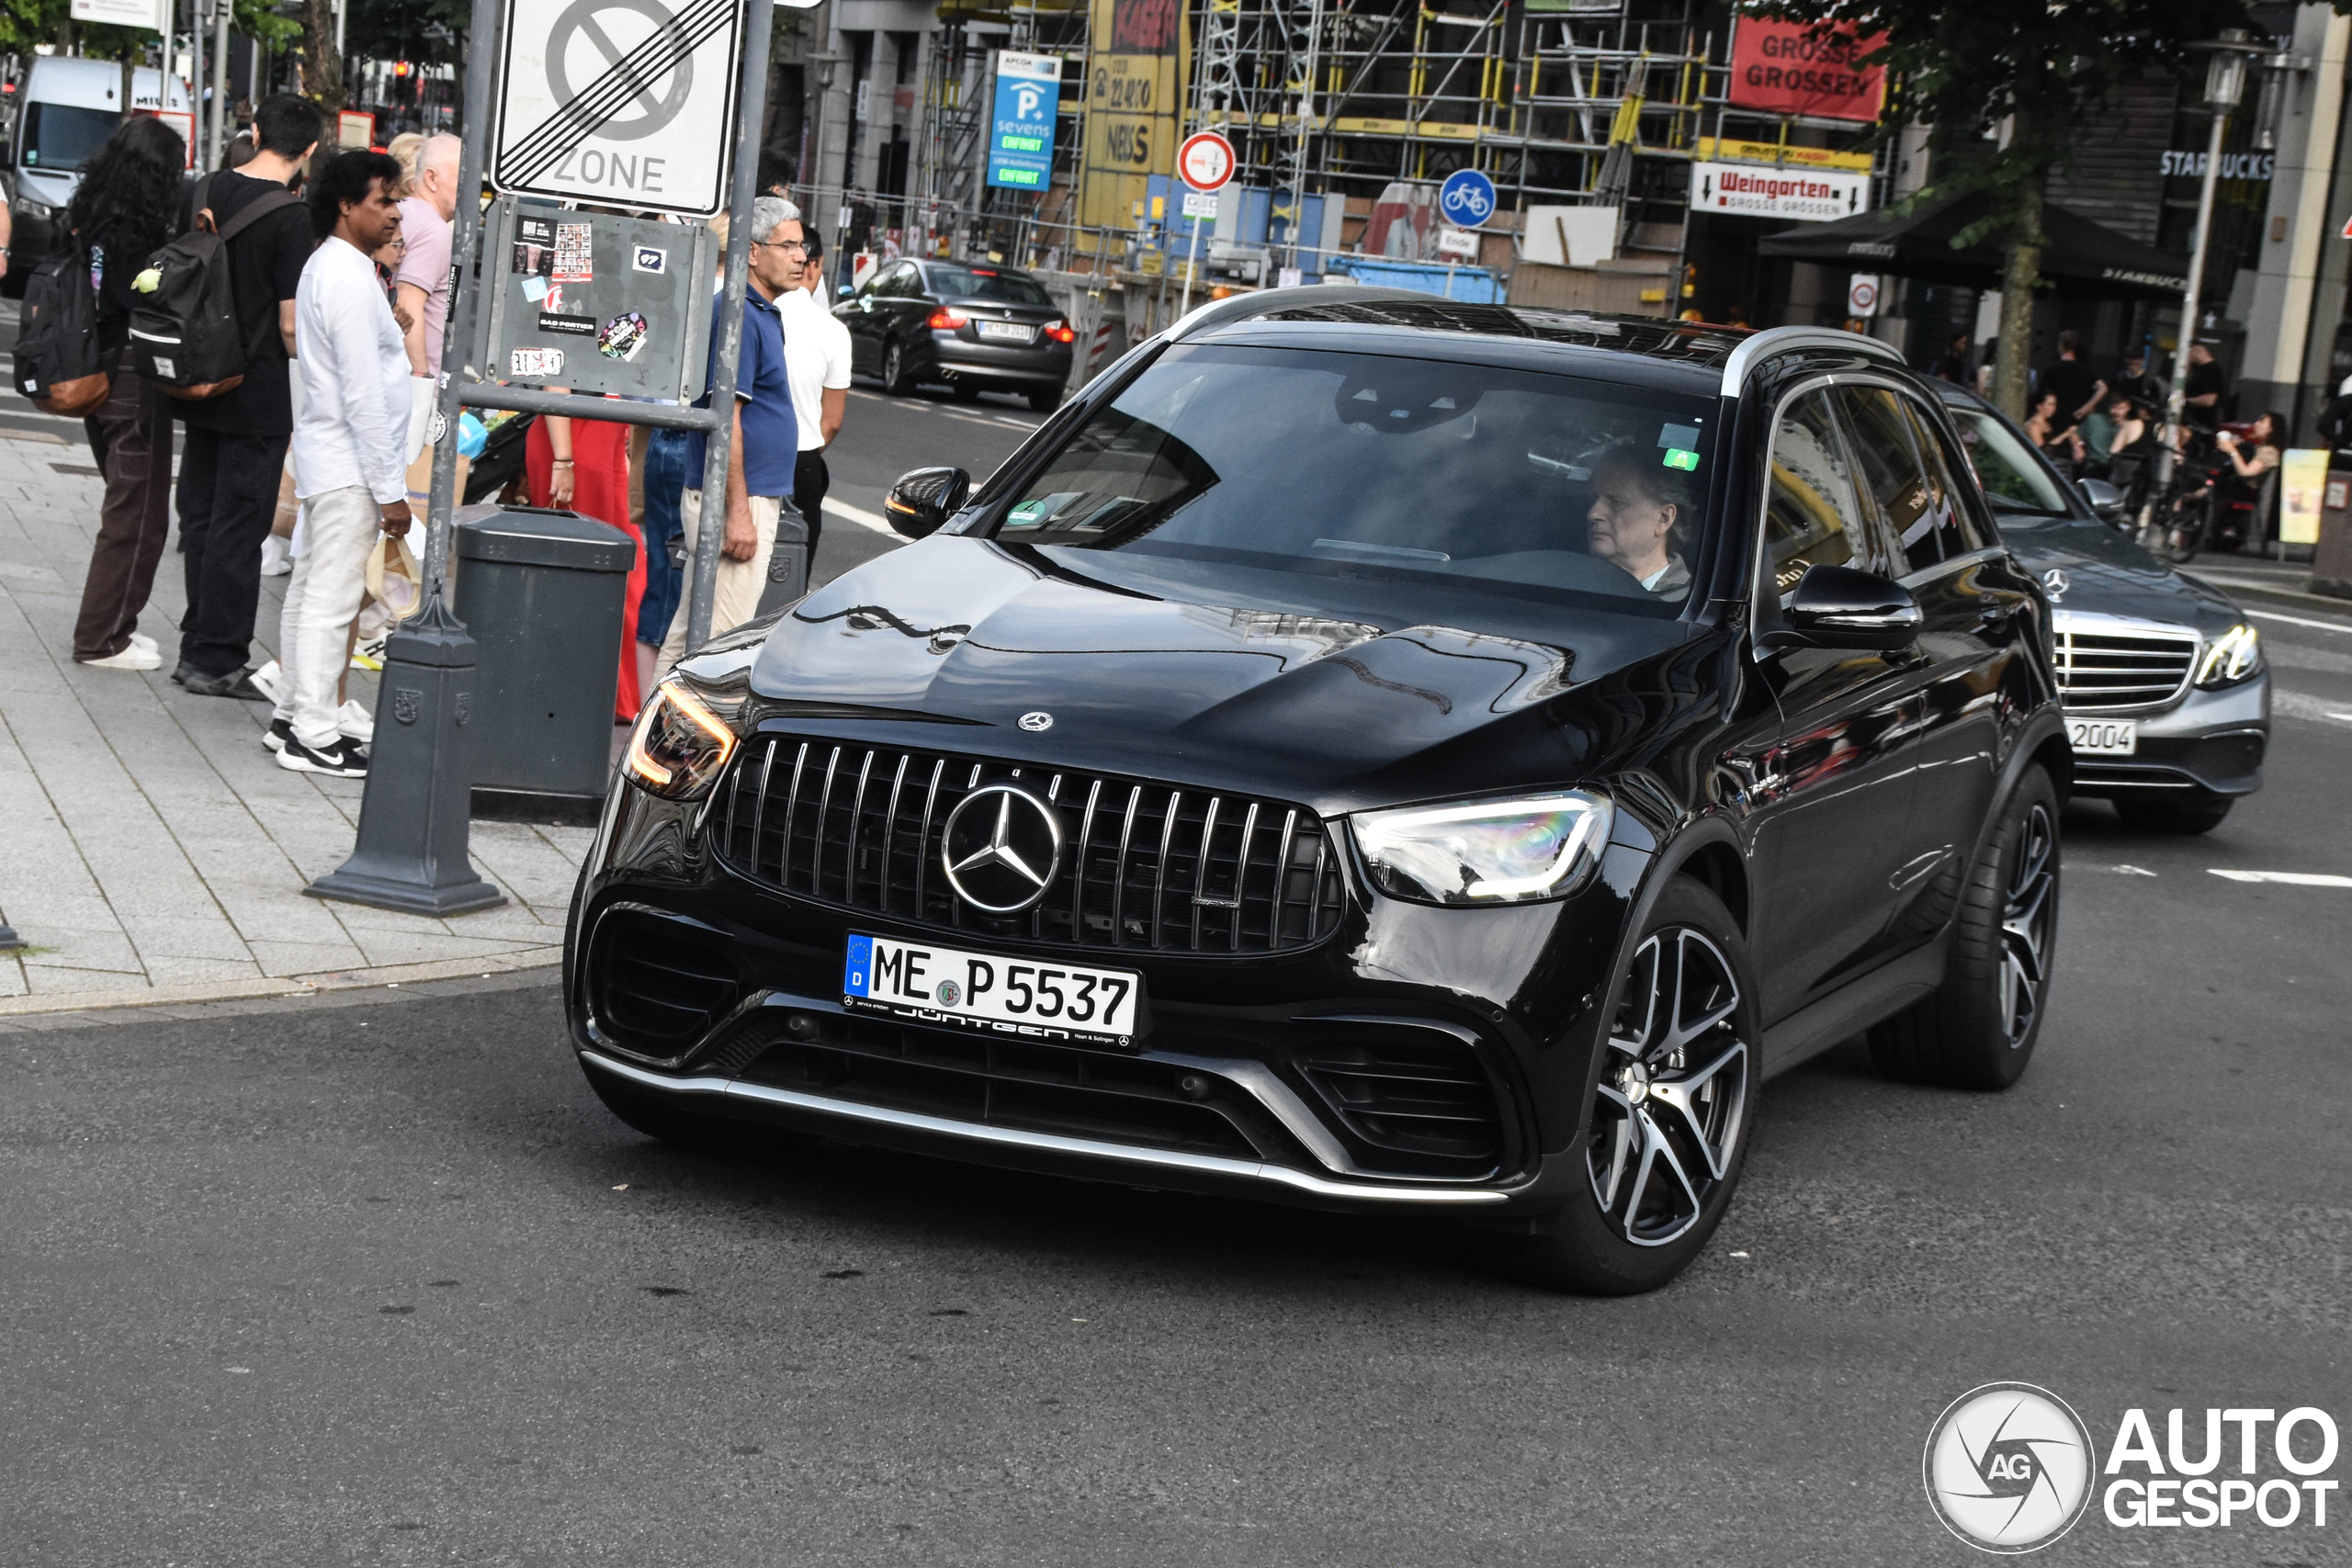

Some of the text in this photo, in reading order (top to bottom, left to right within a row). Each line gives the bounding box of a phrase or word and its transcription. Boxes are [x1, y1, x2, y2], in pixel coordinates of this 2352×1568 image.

[136, 97, 177, 107] MILS
[1017, 90, 1038, 119] P
[997, 119, 1050, 137] sevens
[553, 145, 665, 193] ZONE
[2159, 150, 2274, 180] STARUCKS
[1720, 172, 1830, 199] Weingarten
[1729, 197, 1778, 211] GROSSE
[1446, 235, 1470, 248] Ende
[559, 321, 594, 330] PORTIER
[2074, 724, 2130, 750] 2004
[853, 972, 862, 987] D
[874, 945, 1130, 1026] ME P 5537
[1093, 1035, 1114, 1043] Solingen
